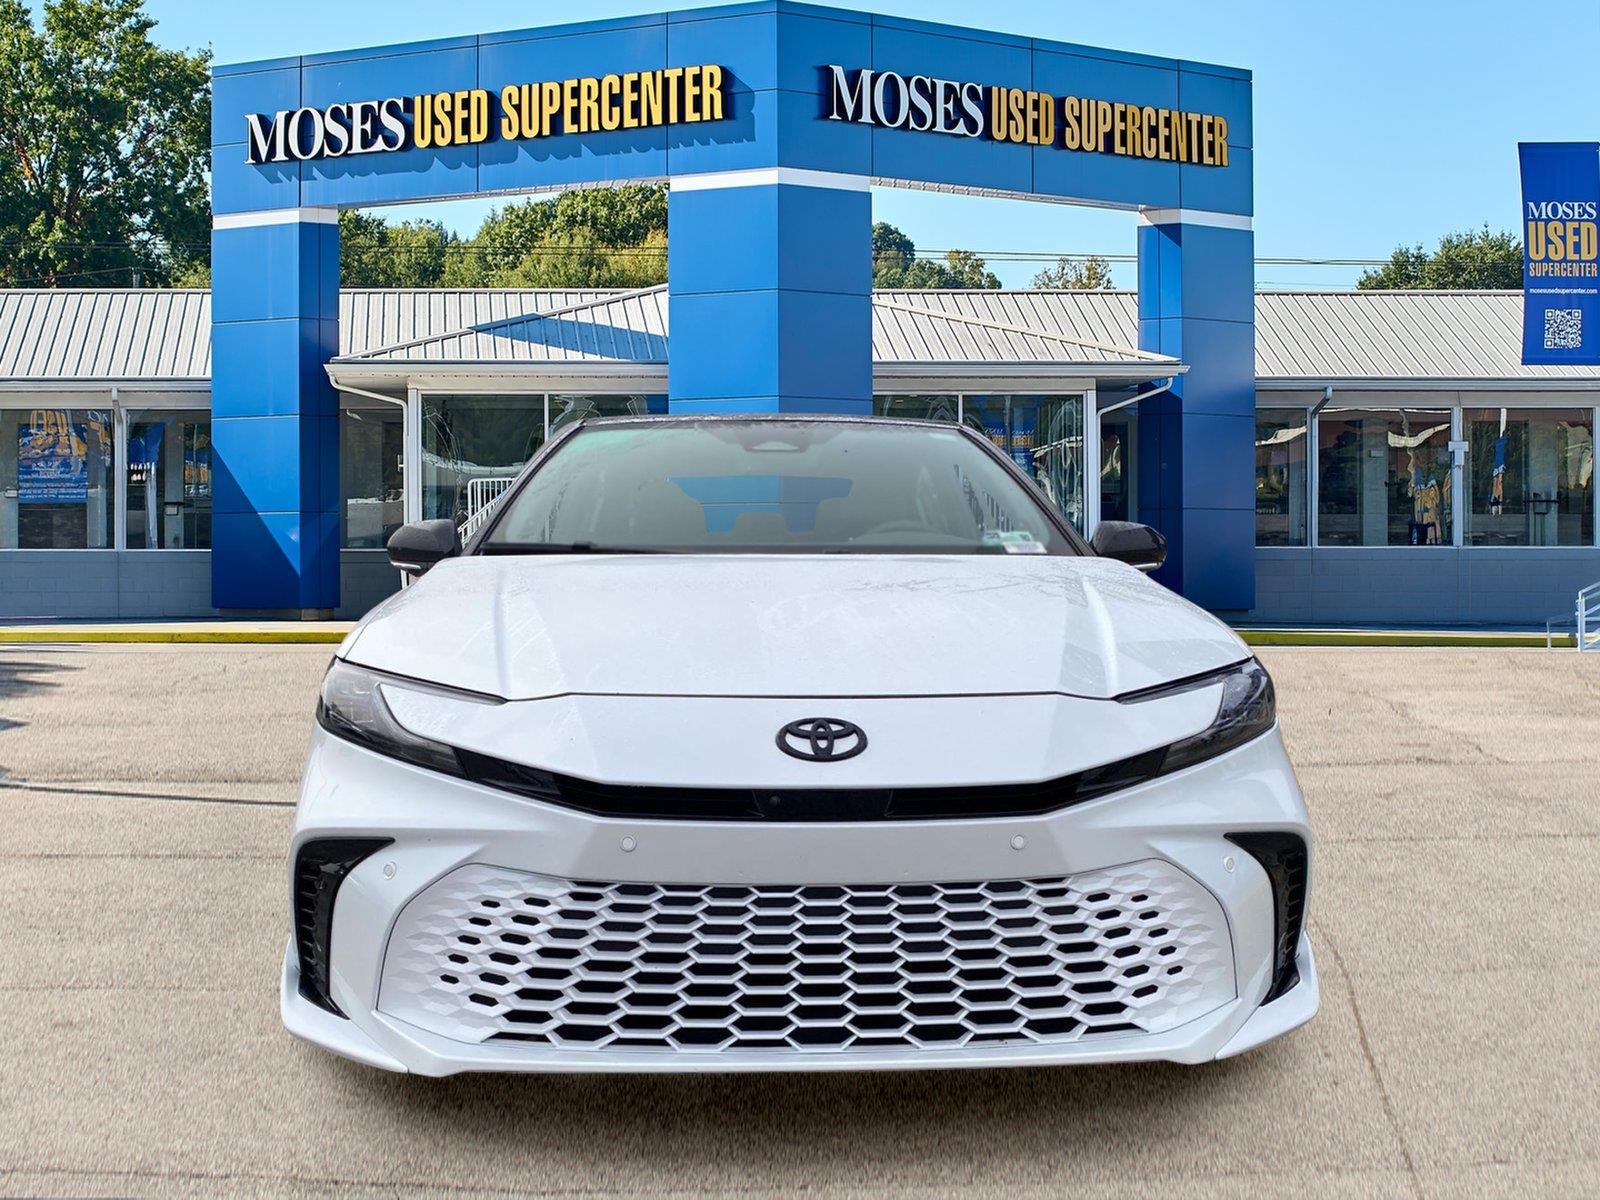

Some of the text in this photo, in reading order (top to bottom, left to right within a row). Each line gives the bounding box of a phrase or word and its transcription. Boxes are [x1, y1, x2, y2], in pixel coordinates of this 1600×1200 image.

[244, 65, 723, 164] MOSES USED SUPERCENTER
[829, 64, 1230, 167] MOSES USED SUPERCENTER
[1527, 201, 1597, 219] MOSES
[1528, 221, 1598, 261] USED
[1529, 262, 1598, 277] SUPERCENTER
